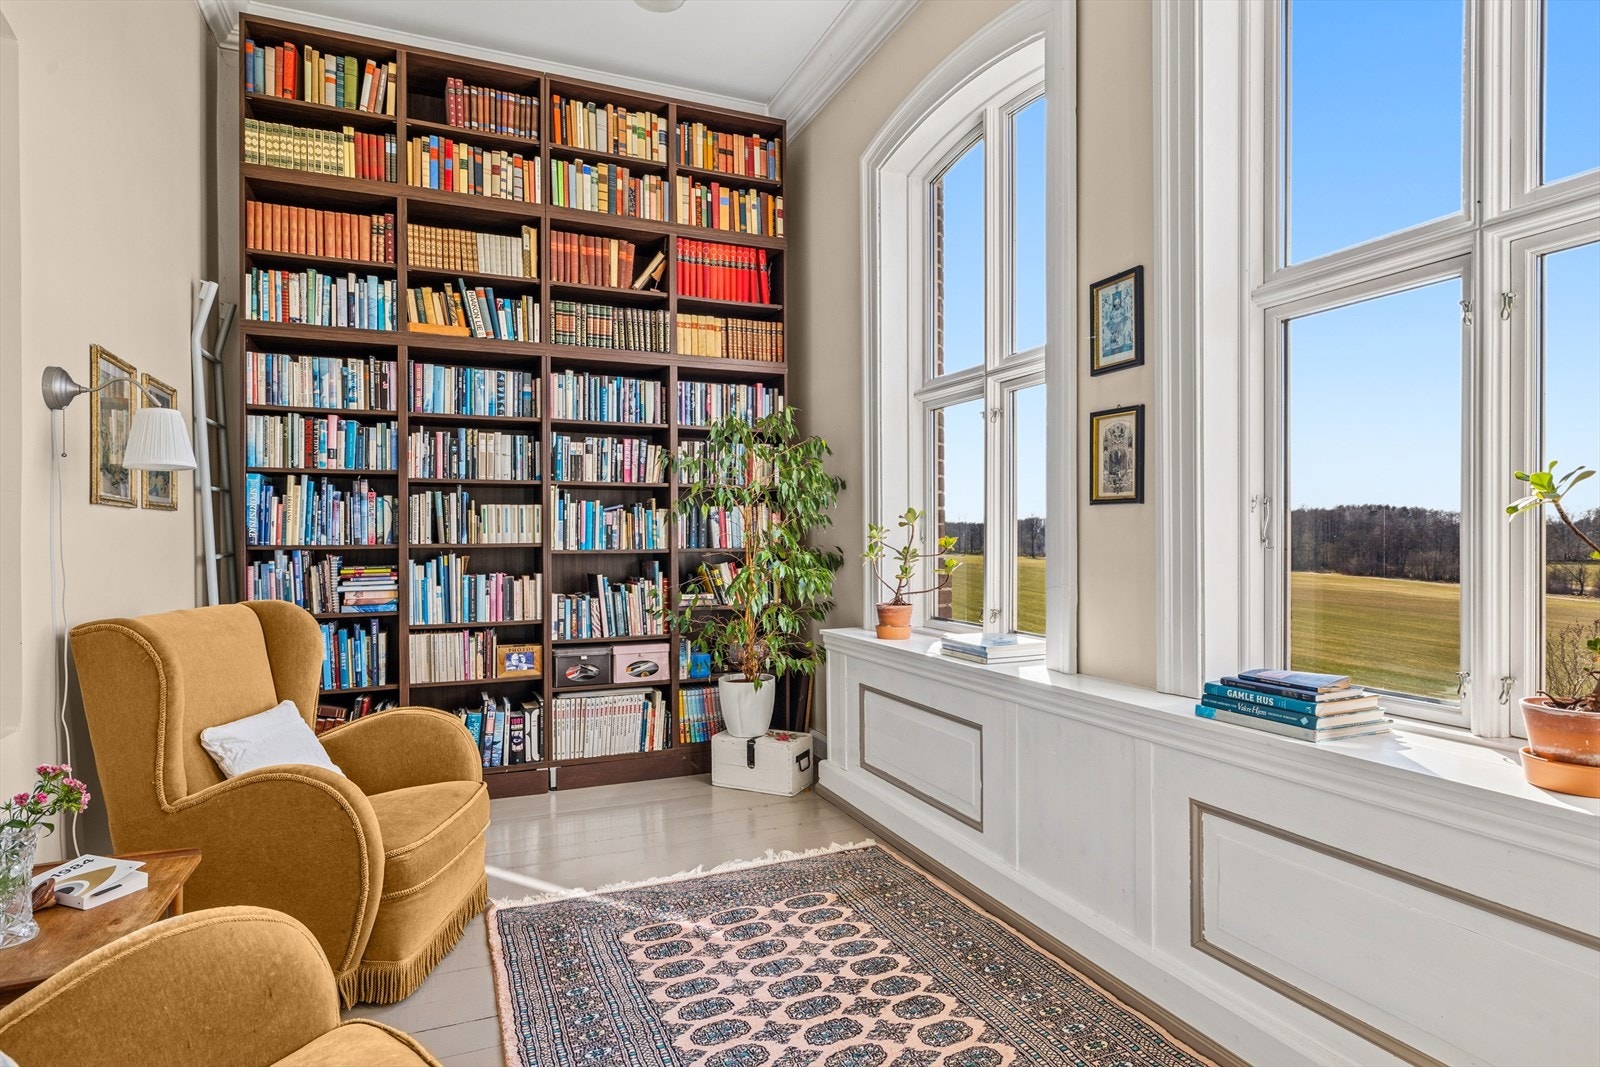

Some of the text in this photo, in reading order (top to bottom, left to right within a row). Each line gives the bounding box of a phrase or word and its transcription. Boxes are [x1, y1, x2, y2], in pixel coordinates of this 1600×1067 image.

[468, 291, 484, 331] HAAKON LIE
[248, 487, 258, 538] SPORTSFISKE
[1226, 689, 1274, 706] GAMLE HUS
[50, 858, 95, 877] 1984
